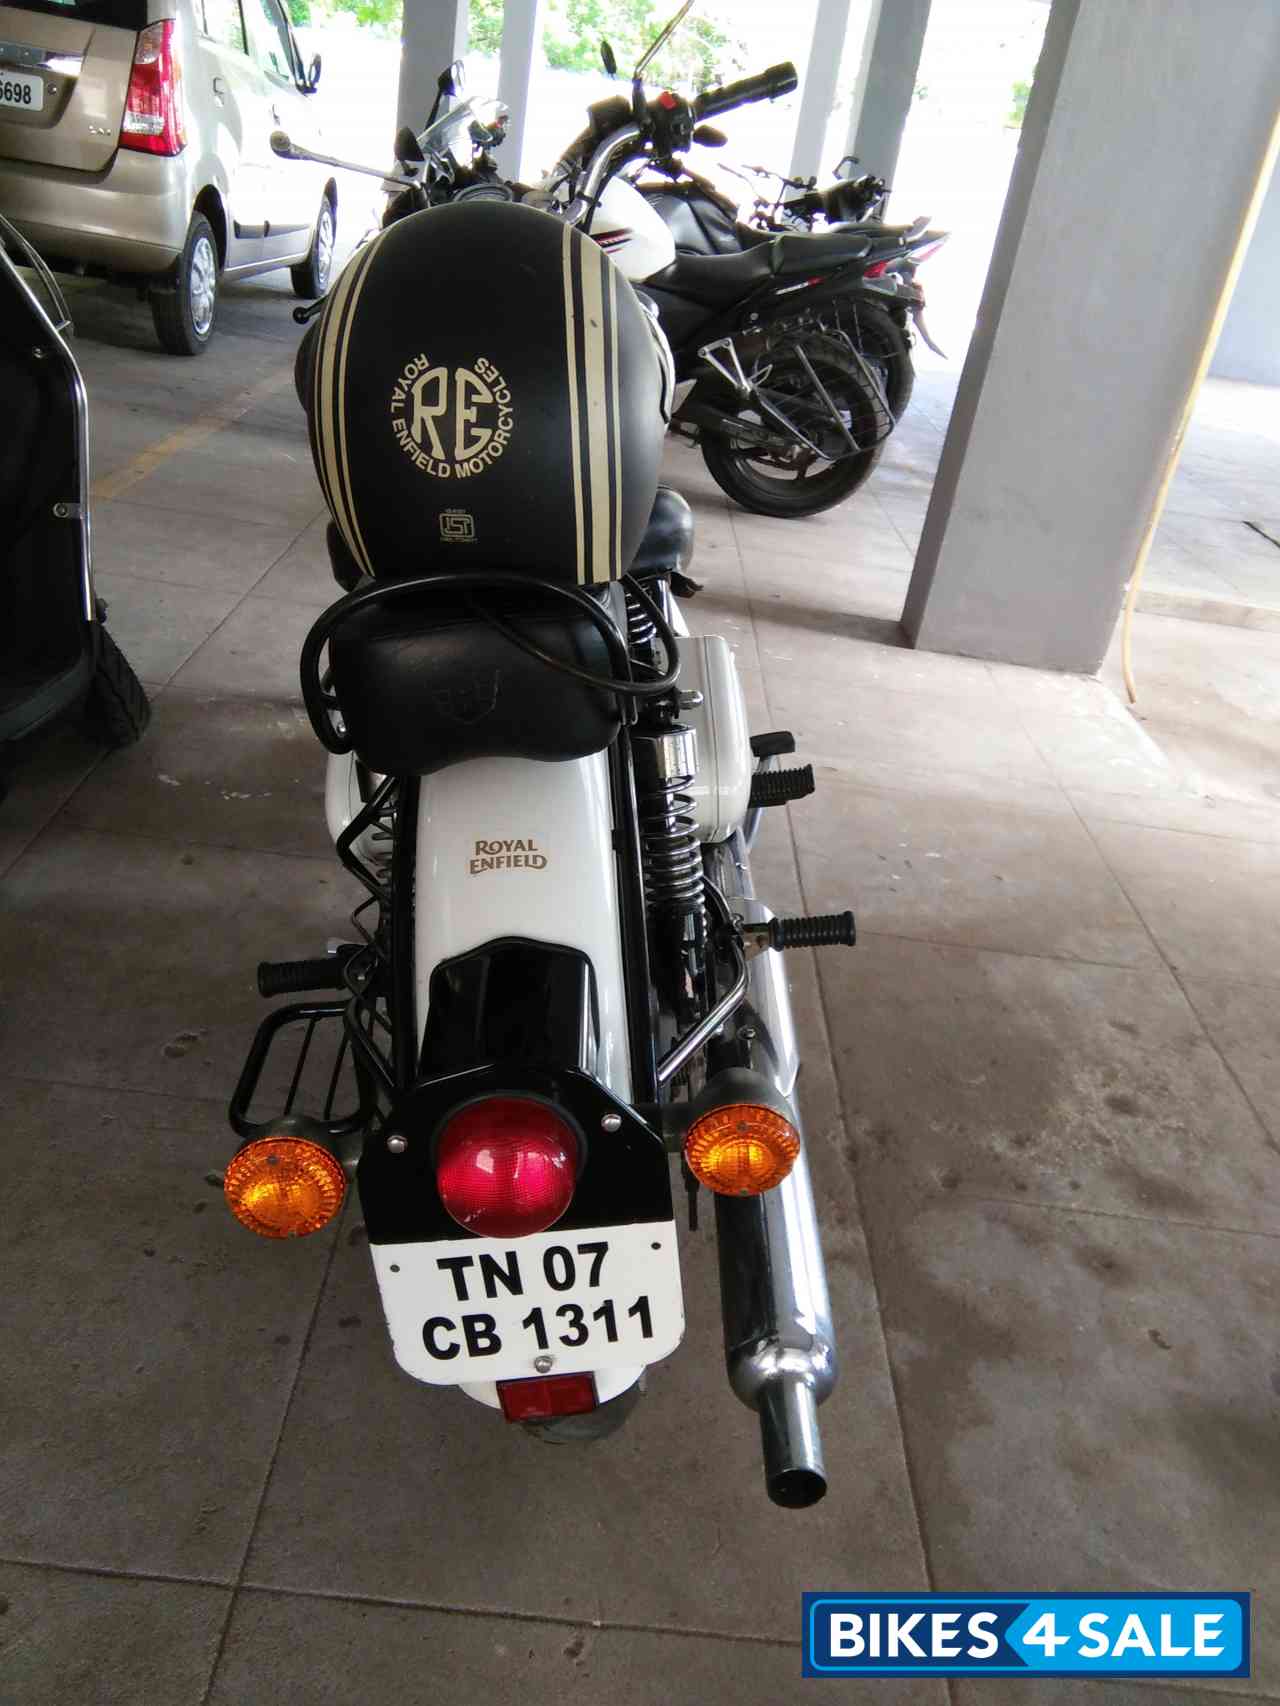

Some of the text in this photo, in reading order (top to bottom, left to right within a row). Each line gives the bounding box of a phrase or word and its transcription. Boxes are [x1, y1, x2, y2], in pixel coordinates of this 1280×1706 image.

[391, 353, 514, 479] ROYAL ENFIELD MOTORCYCLES
[411, 366, 494, 461] RE
[469, 854, 548, 875] ENFIELD
[475, 839, 539, 856] ROYAL
[436, 1241, 609, 1302] TN 07
[422, 1295, 654, 1361] CB 1311
